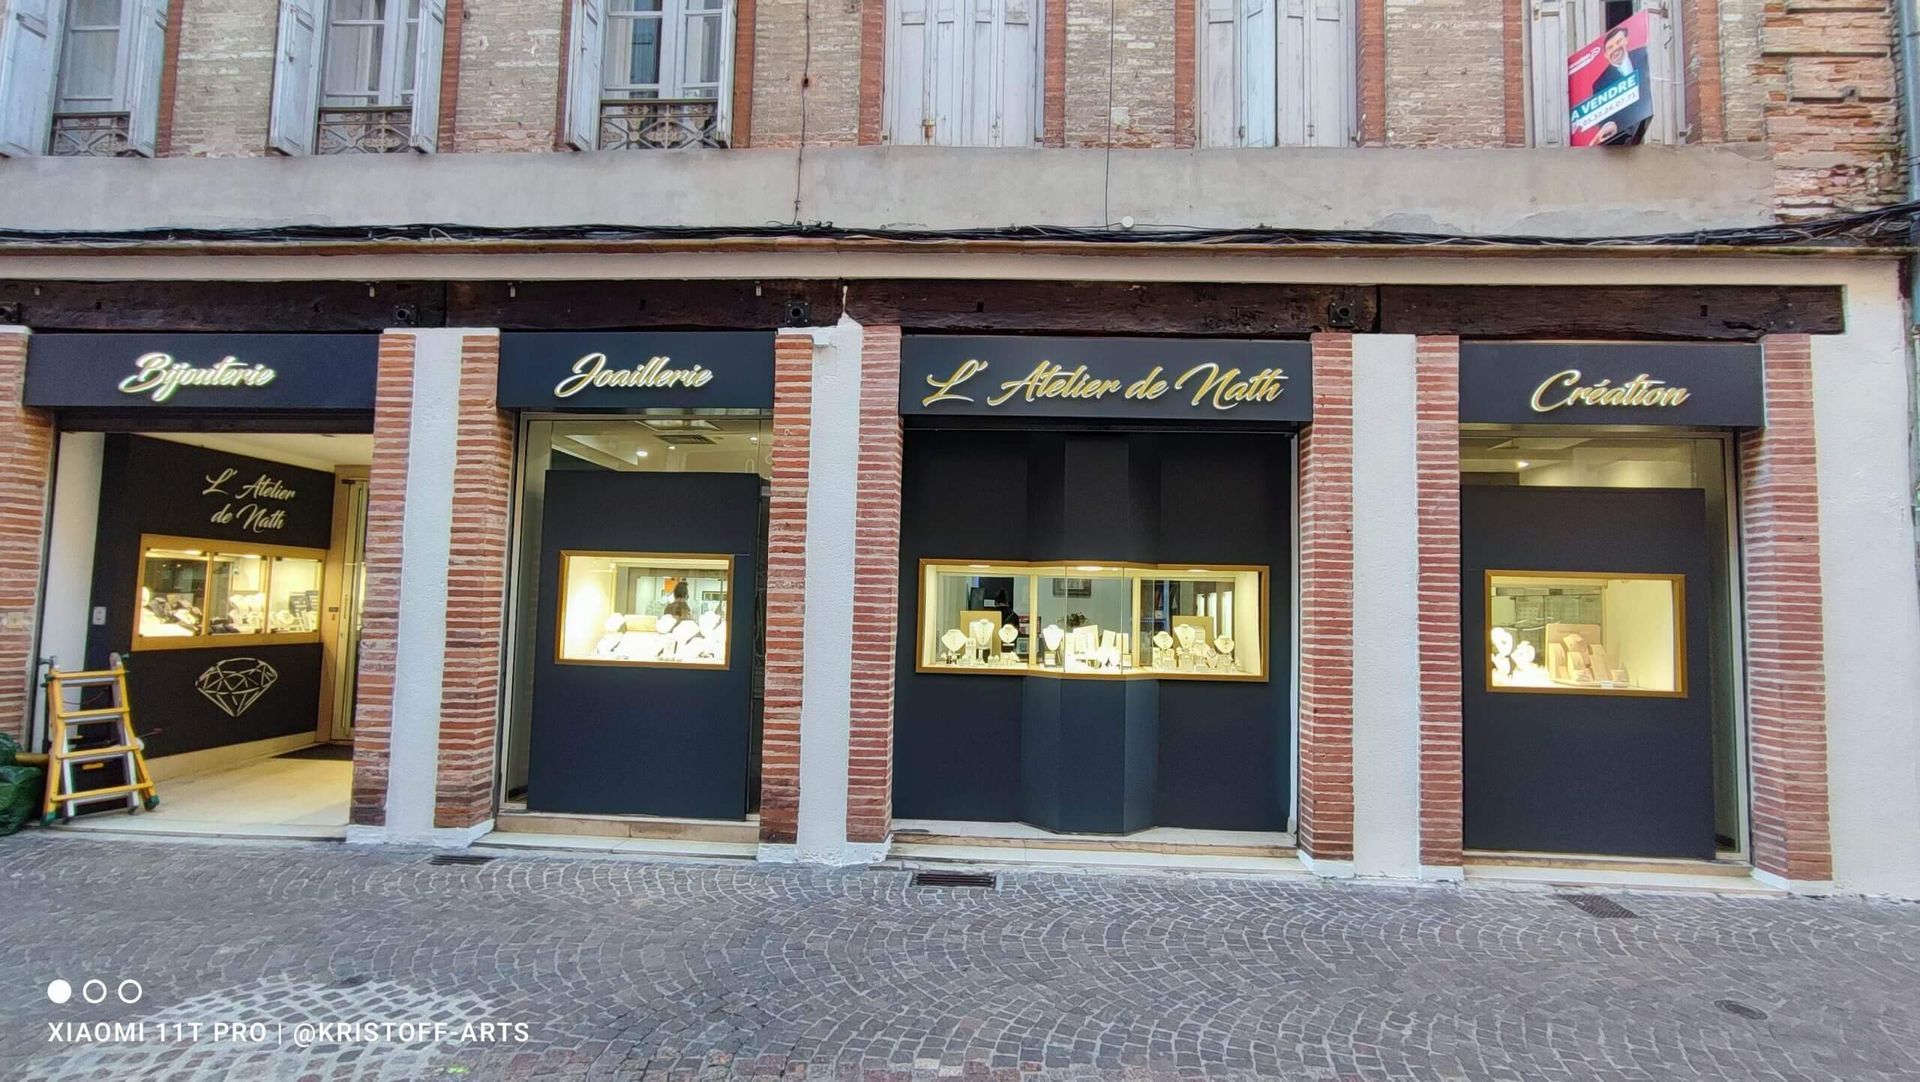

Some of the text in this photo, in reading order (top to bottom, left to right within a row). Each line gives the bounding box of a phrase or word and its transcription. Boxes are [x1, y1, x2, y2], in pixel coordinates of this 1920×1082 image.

[1571, 74, 1637, 122] A VENDRE
[118, 352, 276, 402] Bijouterie
[554, 352, 713, 398] Joaillerie
[922, 359, 1289, 410] L' Atelier de Nath
[1531, 369, 1691, 412] Création
[235, 474, 296, 500] Atelier
[210, 503, 286, 533] de Nath
